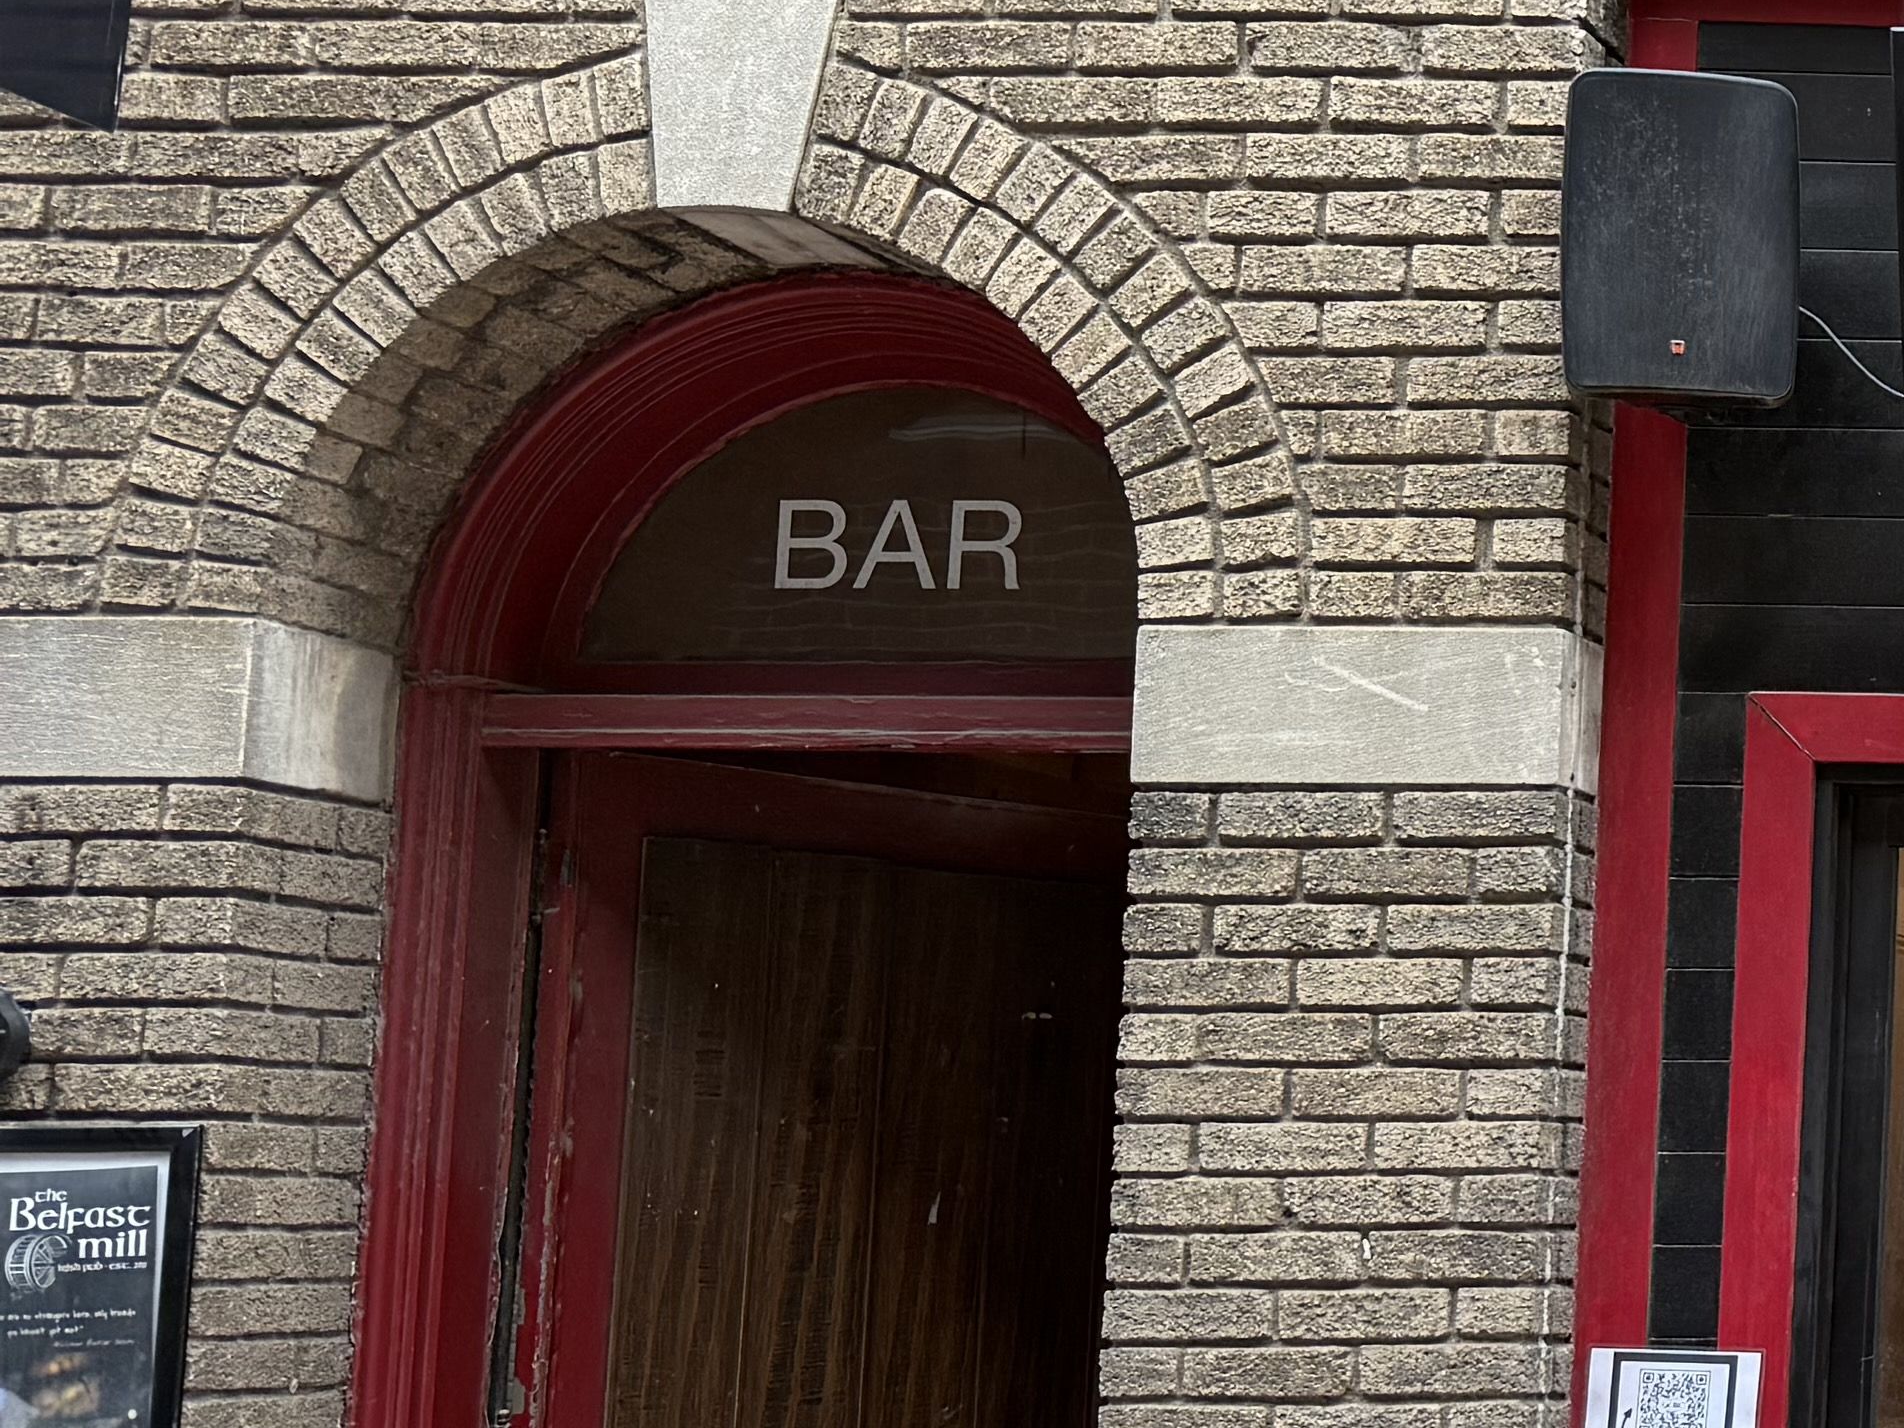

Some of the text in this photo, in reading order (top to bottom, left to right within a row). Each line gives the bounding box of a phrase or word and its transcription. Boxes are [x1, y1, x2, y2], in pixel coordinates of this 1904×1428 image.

[774, 499, 1023, 589] BAR
[35, 1188, 68, 1202] the
[9, 1196, 151, 1234] Belfast
[77, 1228, 148, 1259] mill
